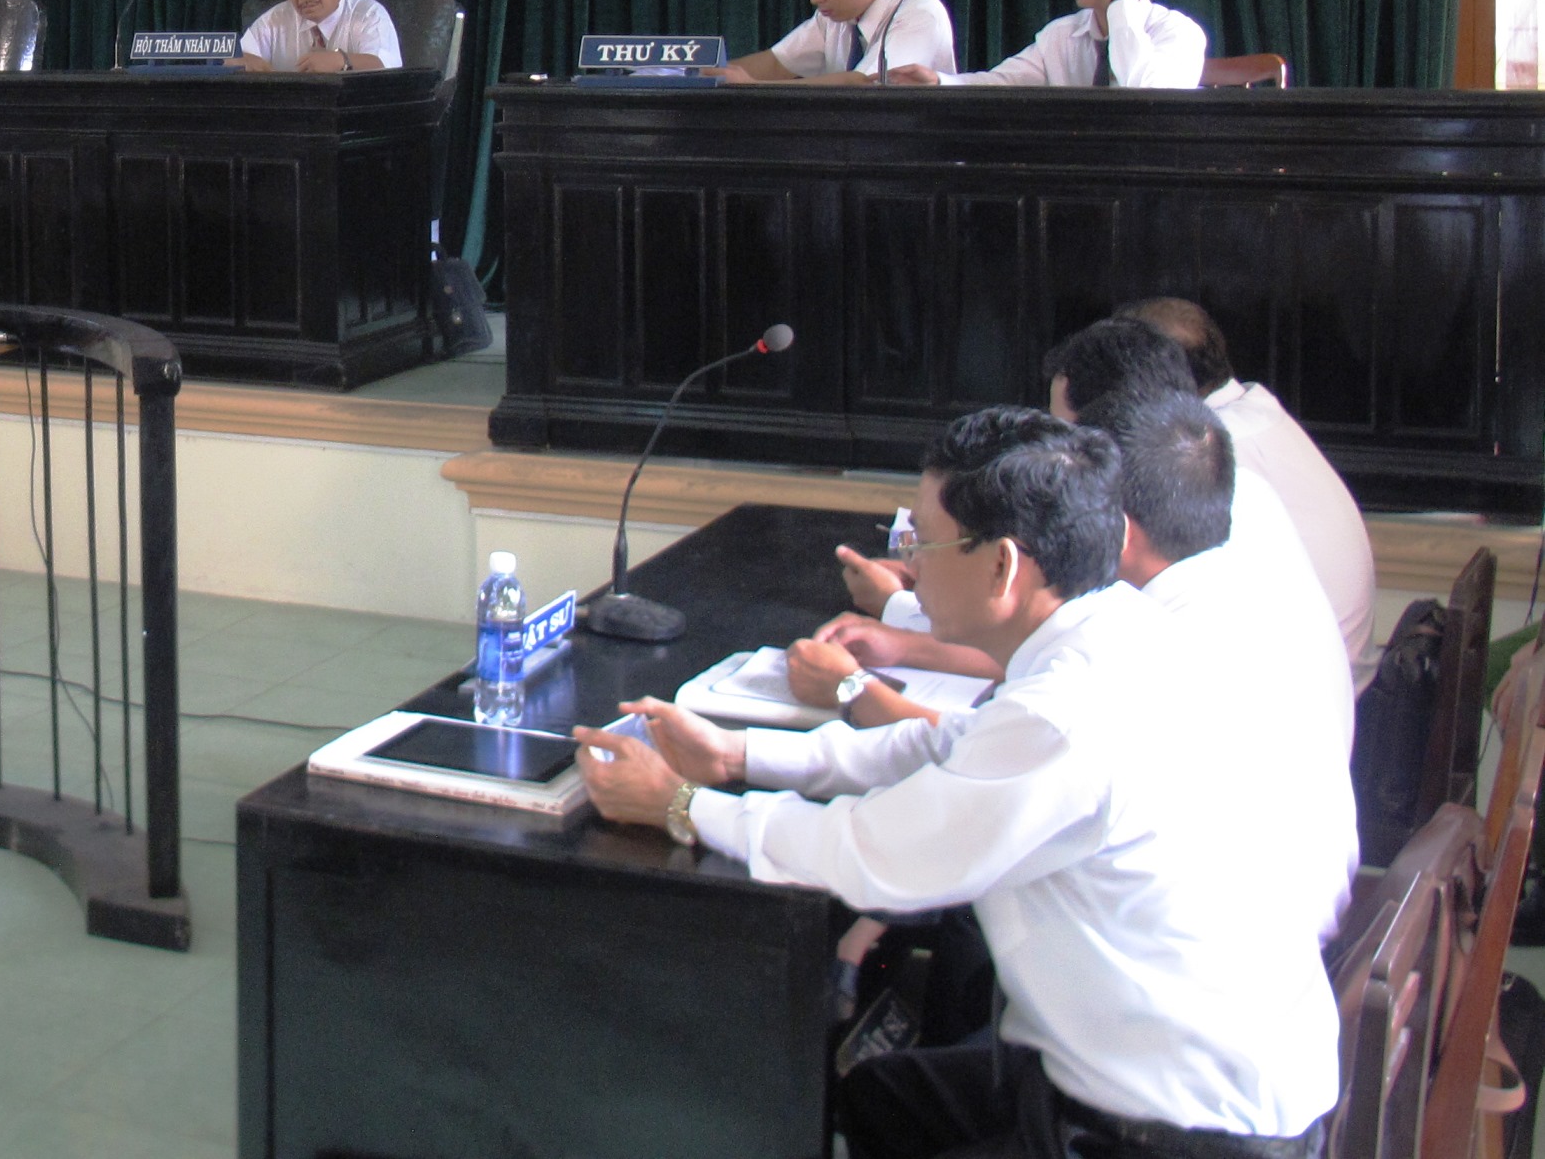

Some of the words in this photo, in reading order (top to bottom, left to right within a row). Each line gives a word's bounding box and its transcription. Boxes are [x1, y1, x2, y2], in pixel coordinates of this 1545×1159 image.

[134, 36, 153, 55] HỘI
[154, 35, 182, 53] THẨM
[183, 36, 211, 53] NHÂN
[212, 36, 234, 53] DÂN
[597, 41, 655, 62] THƯ
[660, 40, 701, 62] KÝ
[549, 601, 571, 633] SƯ
